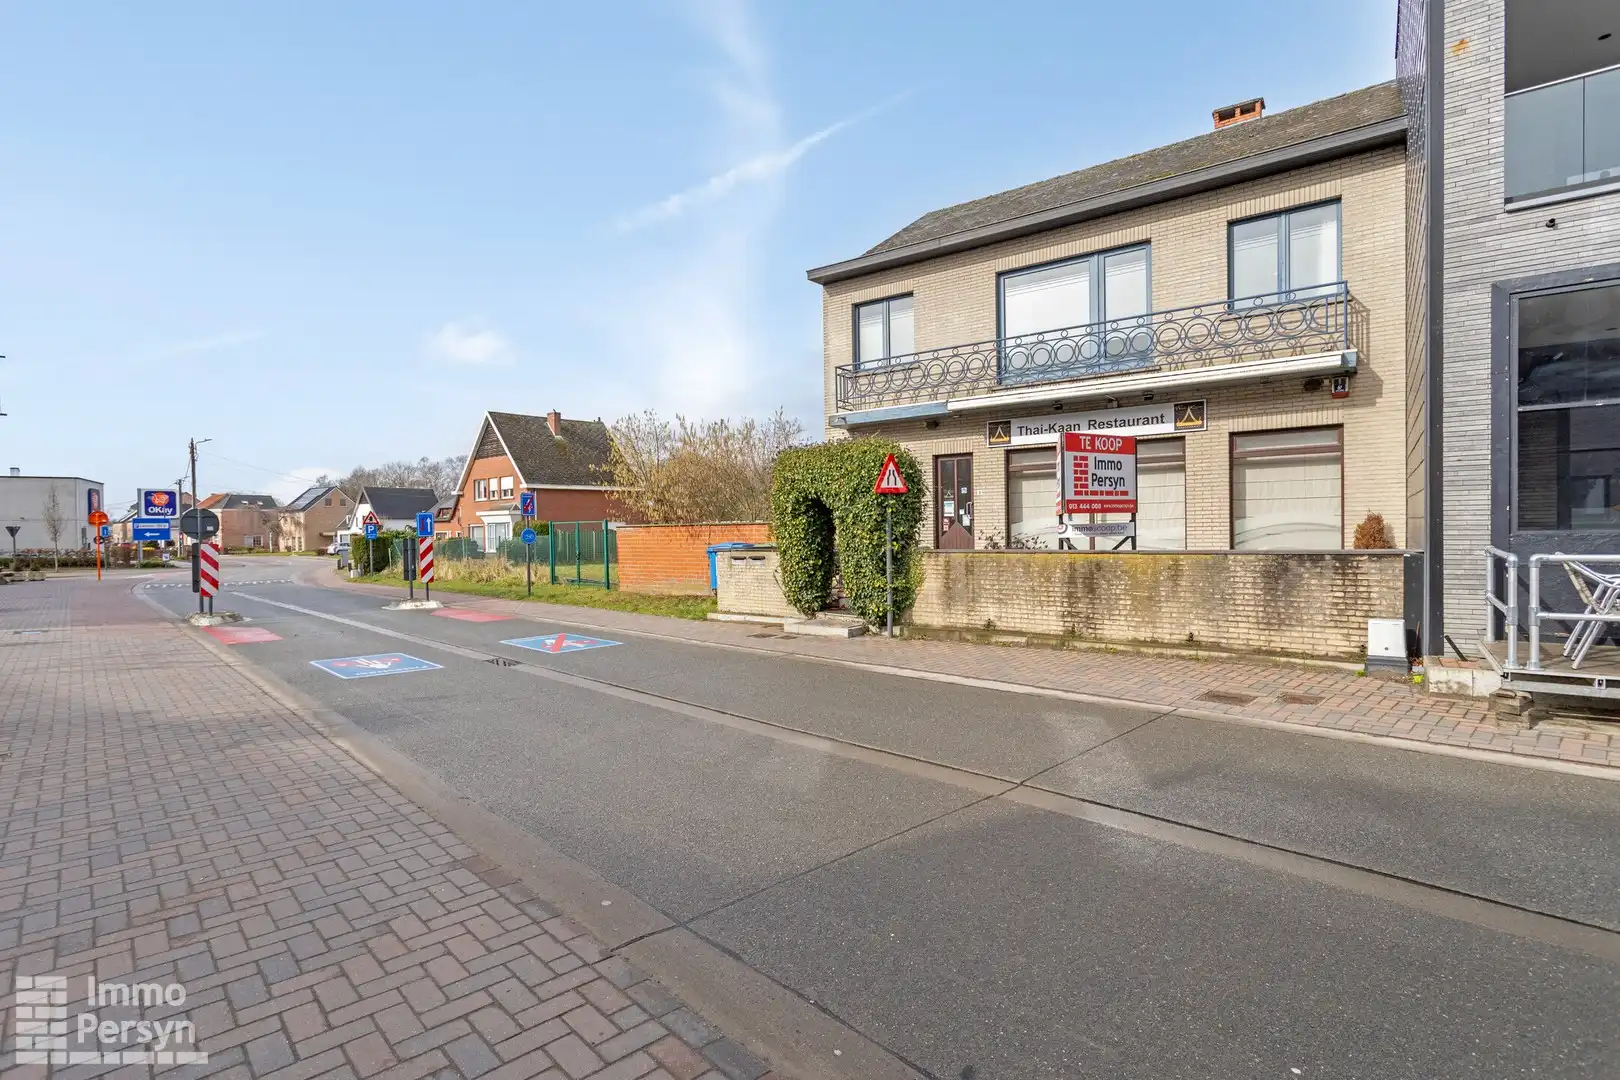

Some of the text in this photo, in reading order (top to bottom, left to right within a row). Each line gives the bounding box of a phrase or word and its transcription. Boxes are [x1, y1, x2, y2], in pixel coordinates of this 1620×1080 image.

[1017, 413, 1165, 436] Thai-Kaan Restaurant
[1079, 436, 1122, 451] TE KOOP
[1094, 456, 1122, 470] Immo
[1091, 473, 1125, 490] Persyn
[367, 525, 375, 534] P
